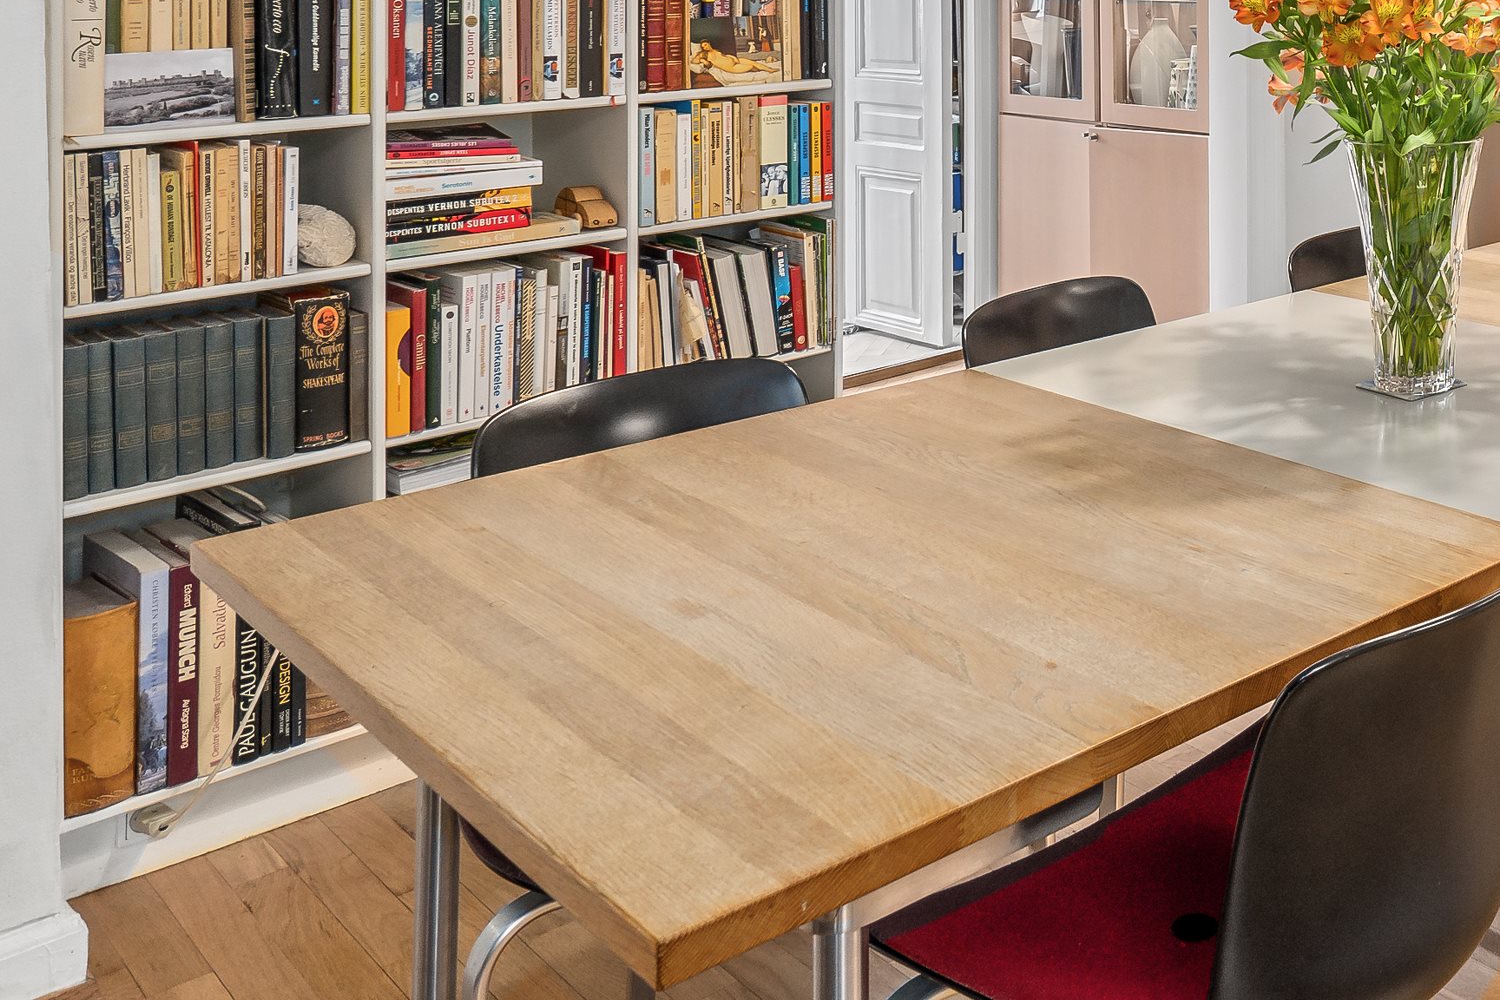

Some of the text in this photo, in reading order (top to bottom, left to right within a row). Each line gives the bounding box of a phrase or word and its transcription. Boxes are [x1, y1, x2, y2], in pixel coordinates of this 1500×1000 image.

[272, 18, 280, 34] eco
[393, 0, 403, 39] Oksanen
[568, 0, 577, 44] MORRISON
[79, 50, 88, 68] navn
[434, 23, 442, 75] ALEXIEVICH
[467, 30, 476, 80] Junot Díaz
[442, 180, 472, 190] Serotonin
[388, 206, 425, 216] DESPENTES
[428, 199, 466, 212] VERNON
[469, 195, 510, 208] SUBUTEX
[122, 216, 131, 244] François
[426, 220, 464, 234] VERNON
[466, 216, 508, 228] SUBUTEX
[510, 214, 516, 222] 1
[458, 236, 479, 247] Sun
[482, 235, 492, 244] is
[415, 334, 426, 370] Camilla
[464, 328, 472, 354] Platform
[493, 324, 504, 396] Underkastelse
[179, 584, 197, 750] Edvard MUNCH Av Ragna Stang
[279, 662, 291, 704] DESIGN
[212, 666, 223, 758] Centre Georges Pompidou
